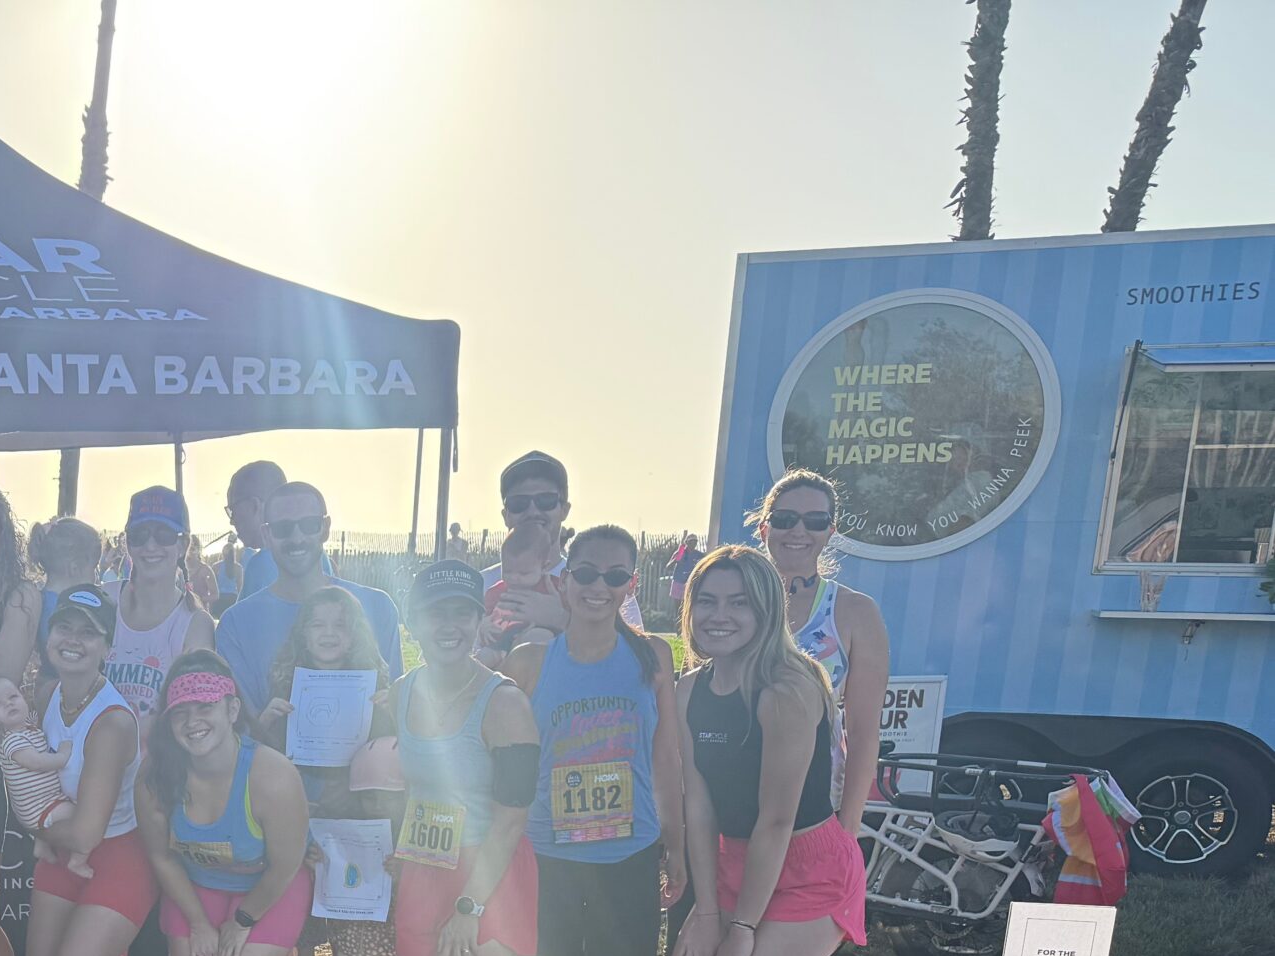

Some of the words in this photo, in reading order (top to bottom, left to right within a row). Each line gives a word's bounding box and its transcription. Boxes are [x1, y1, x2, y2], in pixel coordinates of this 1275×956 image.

[1126, 282, 1261, 305] SMOOTHIES
[153, 355, 417, 396] BARBARA
[834, 363, 932, 386] WHERE
[831, 391, 883, 412] THE
[827, 416, 915, 439] MAGIC
[826, 442, 953, 465] HAPPENS
[839, 509, 867, 530] YOU
[875, 523, 918, 537] KNOW
[928, 511, 959, 532] YOU
[968, 468, 1015, 510] WANNA
[1010, 416, 1032, 458] PEEK
[106, 663, 164, 693] MMER
[118, 683, 154, 699] RNED
[882, 689, 925, 709] DEN
[551, 696, 638, 728] OPPORTUNITY
[879, 710, 909, 730] UR
[594, 773, 619, 784] HOKA
[563, 784, 622, 814] 1182
[408, 821, 454, 852] 1600
